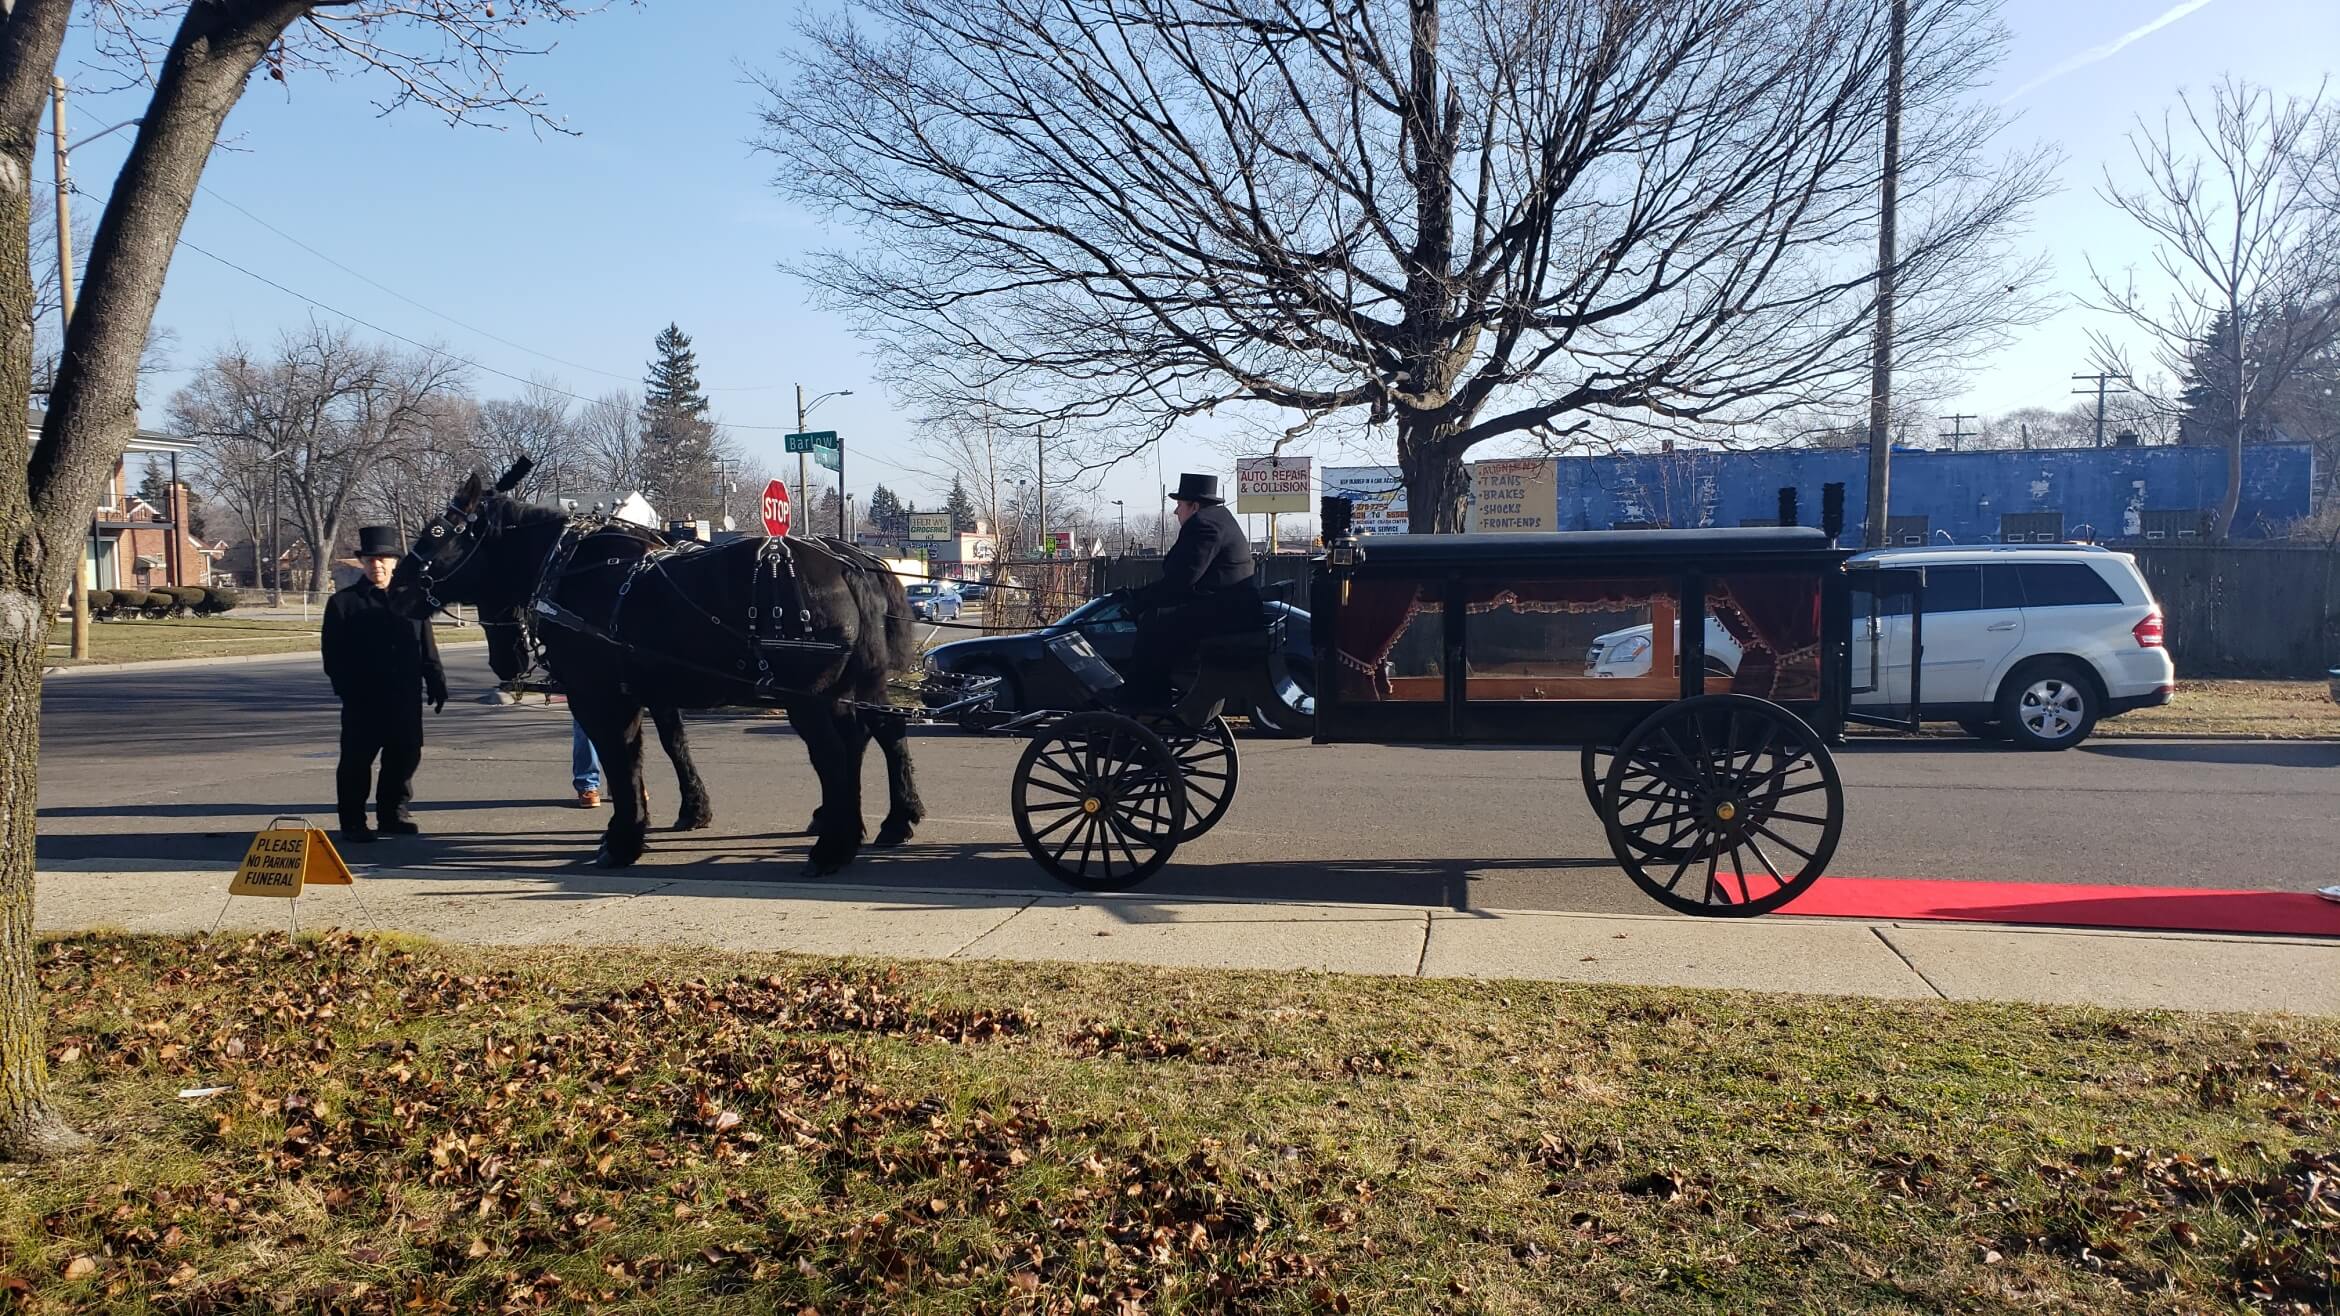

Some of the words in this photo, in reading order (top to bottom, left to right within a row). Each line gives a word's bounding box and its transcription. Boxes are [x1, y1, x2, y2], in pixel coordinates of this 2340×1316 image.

[789, 435, 833, 451] Barlow
[1240, 470, 1268, 482] AUTO
[1272, 469, 1307, 481] REPAIR
[1240, 482, 1248, 493] &
[1253, 481, 1308, 493] COLLISION
[1483, 489, 1525, 500] BRAKES
[764, 497, 789, 523] STOP
[1483, 503, 1521, 515] SHOCKS
[1483, 517, 1541, 529] FRONT-ENDS
[910, 526, 948, 534] GROCERIES
[257, 838, 304, 853] PLEASE
[246, 855, 261, 868] NO
[262, 855, 302, 869] PARKING
[245, 871, 294, 886] FUNERAL
